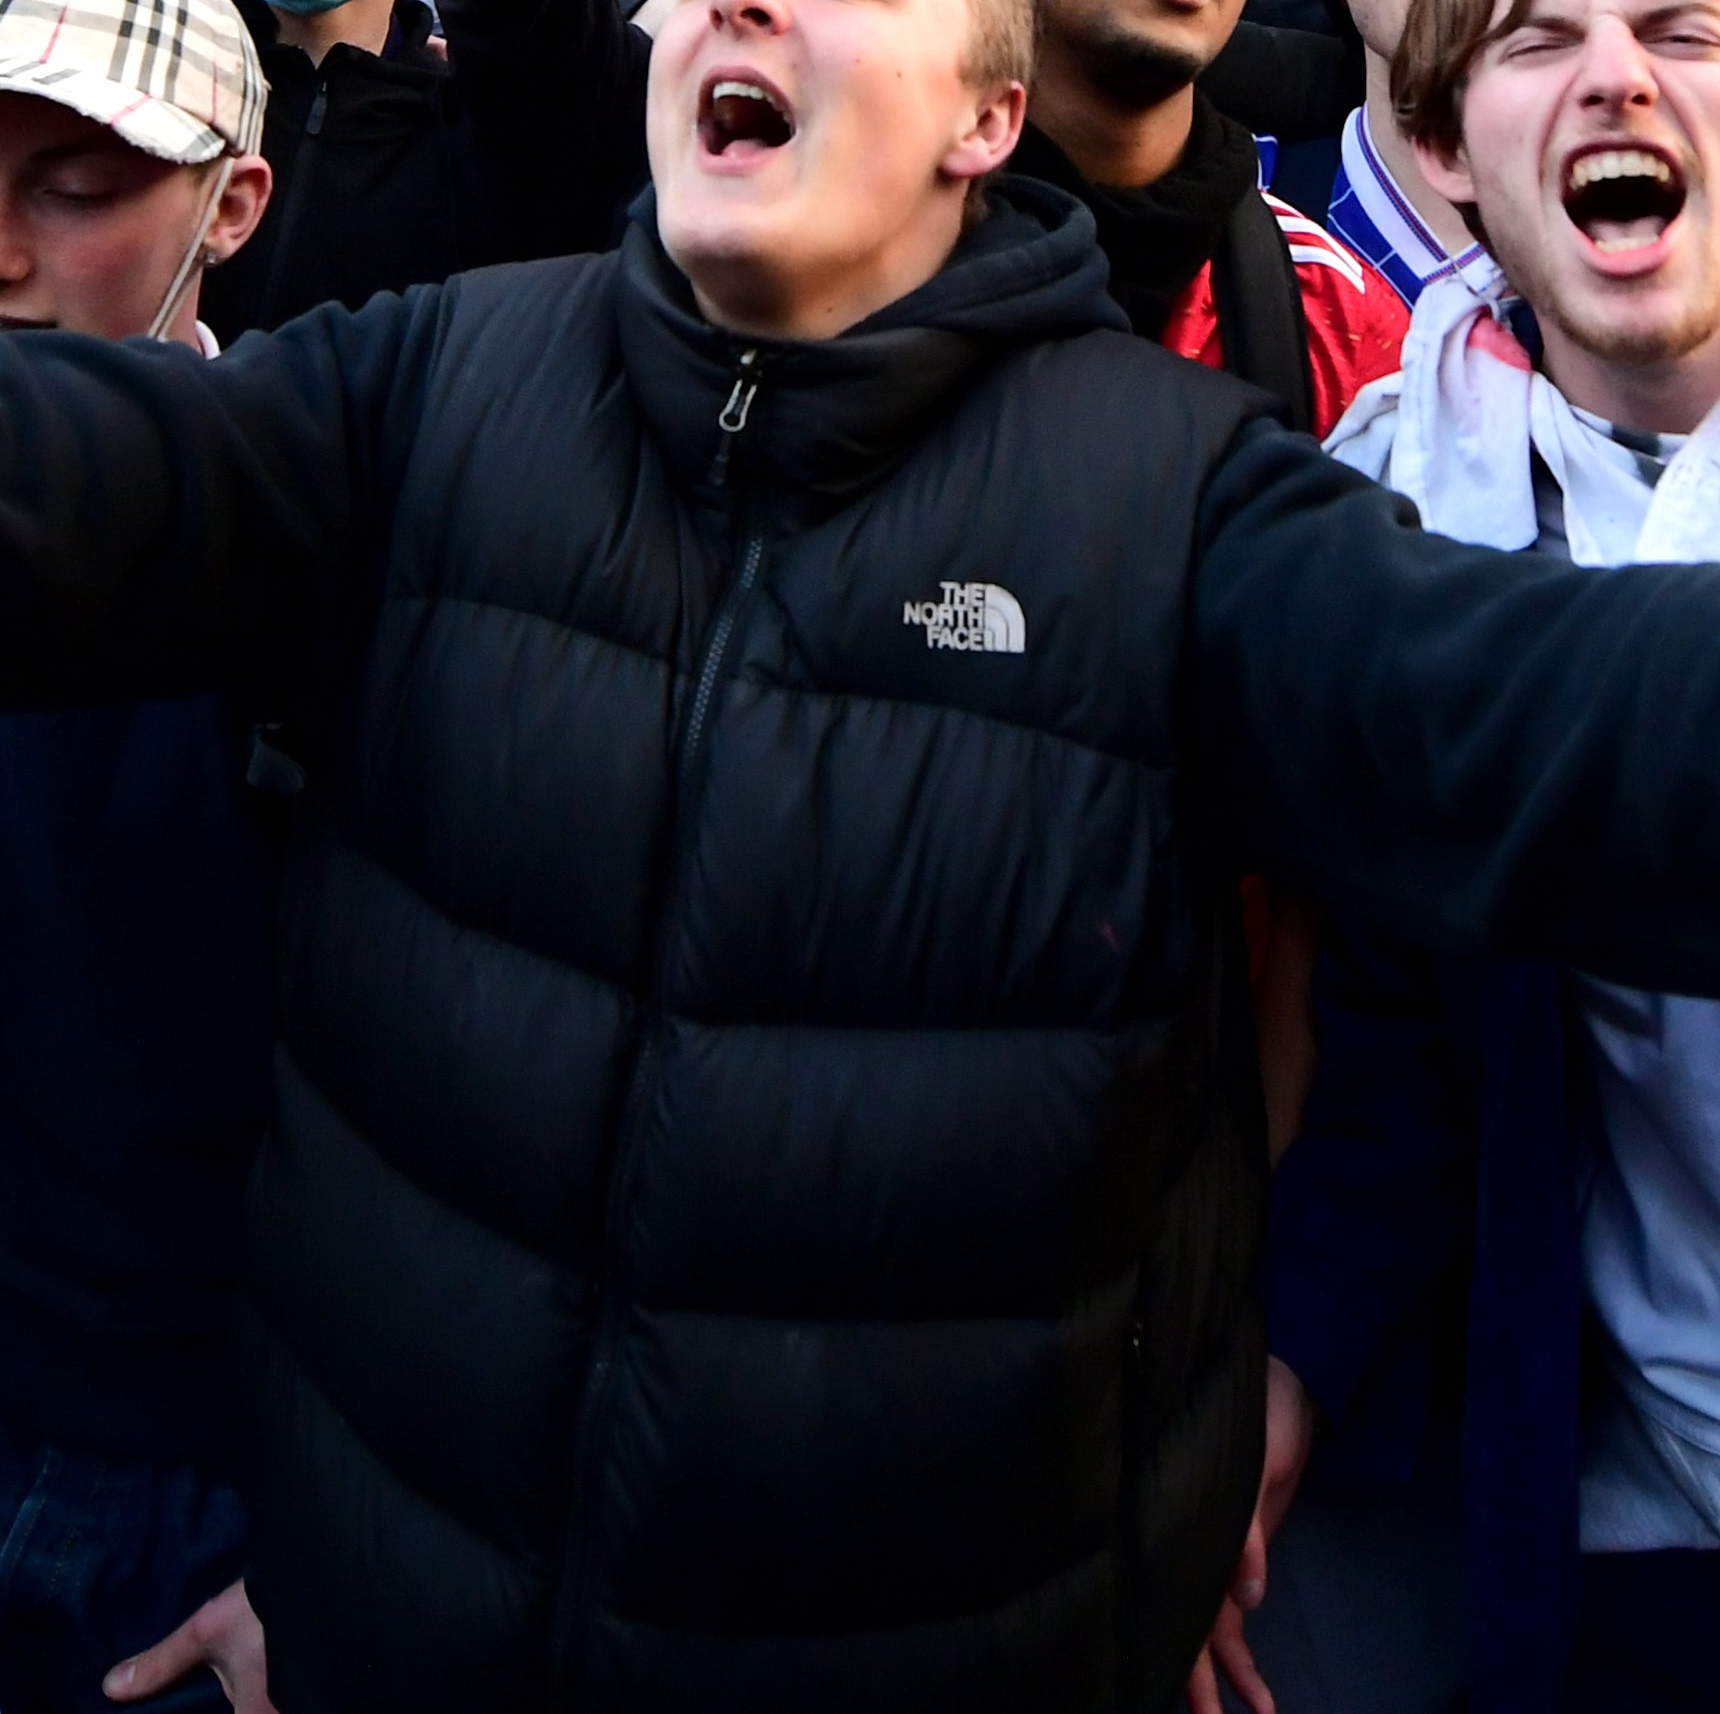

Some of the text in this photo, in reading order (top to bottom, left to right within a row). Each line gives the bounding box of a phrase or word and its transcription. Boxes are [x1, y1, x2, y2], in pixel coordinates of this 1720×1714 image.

[938, 580, 986, 608] THE
[902, 601, 986, 629] NORTH
[925, 626, 985, 652] FACE
